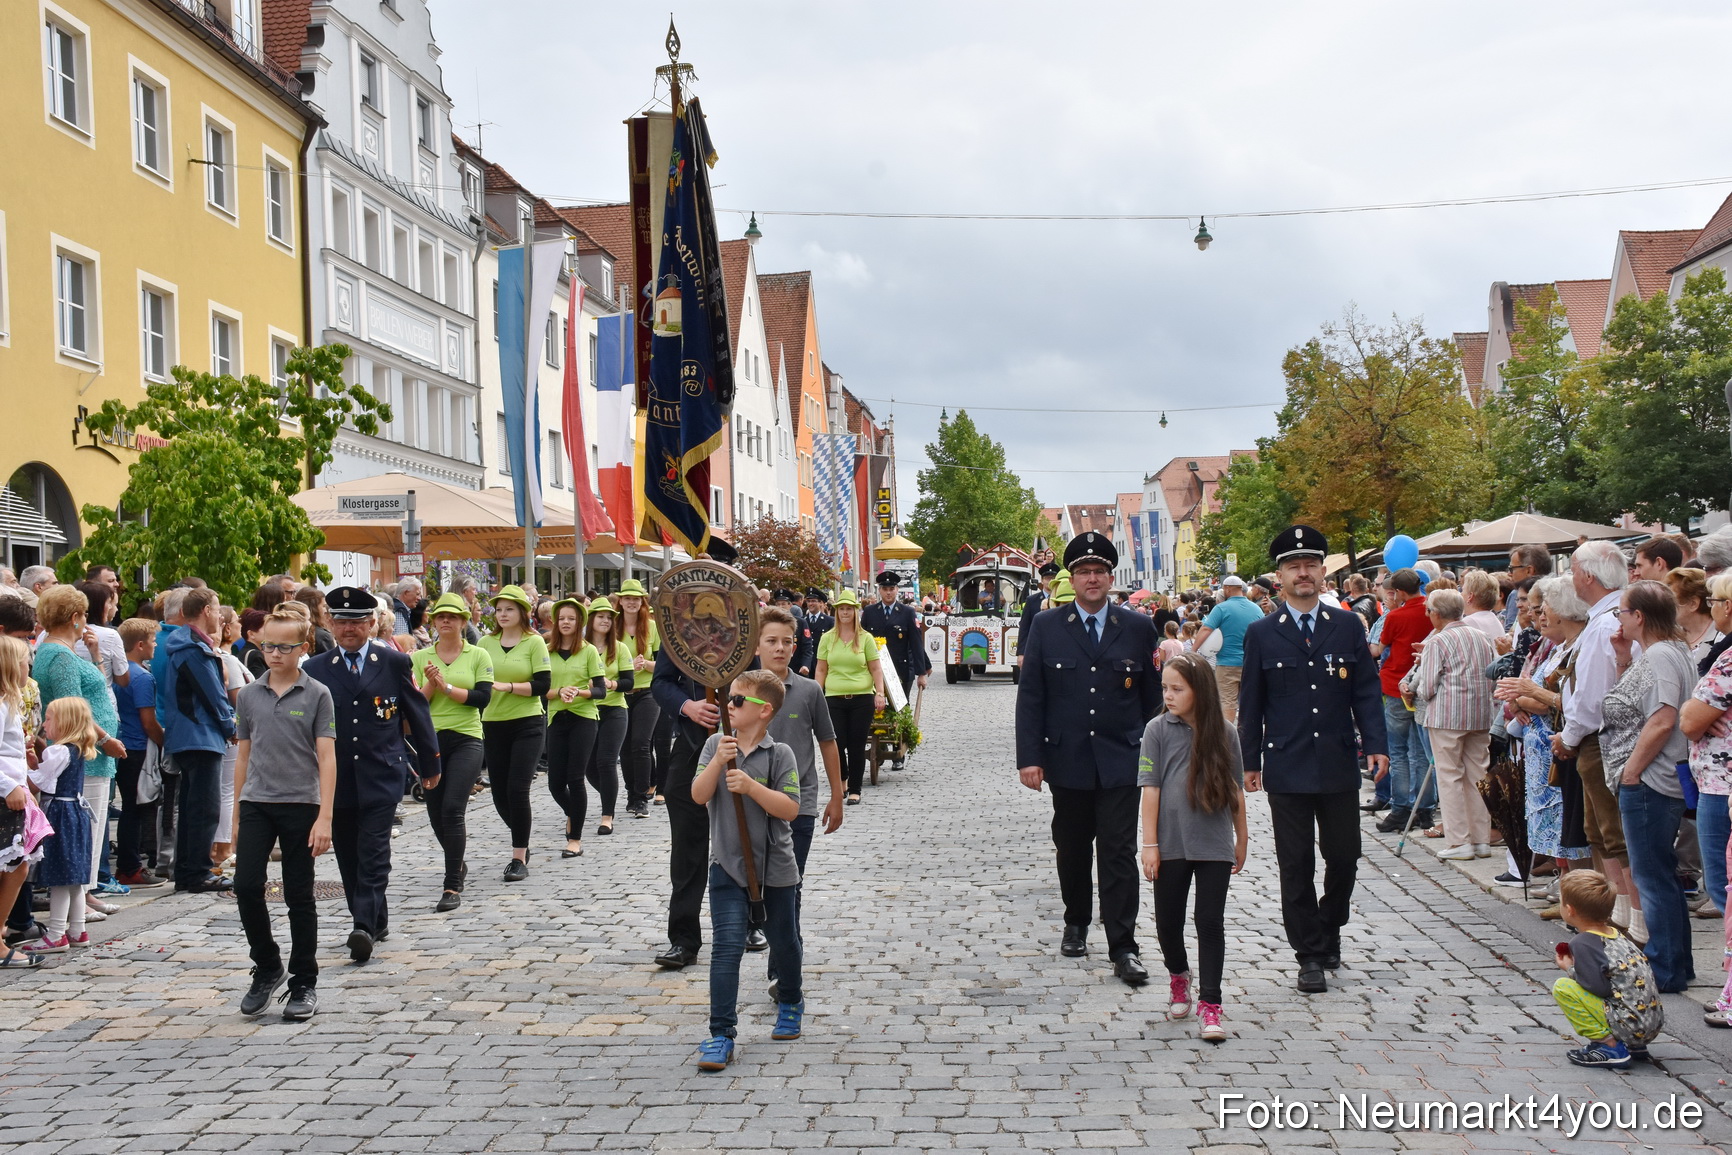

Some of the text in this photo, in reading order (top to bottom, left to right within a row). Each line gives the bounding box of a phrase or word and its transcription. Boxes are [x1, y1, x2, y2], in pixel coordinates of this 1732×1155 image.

[370, 305, 434, 353] BRILLEN WEBER
[342, 498, 400, 511] Klostergasse
[878, 489, 891, 541] HOTE
[666, 569, 734, 590] MANTLACH
[935, 617, 967, 627] HENGER
[717, 608, 750, 679] FEUERWEHR
